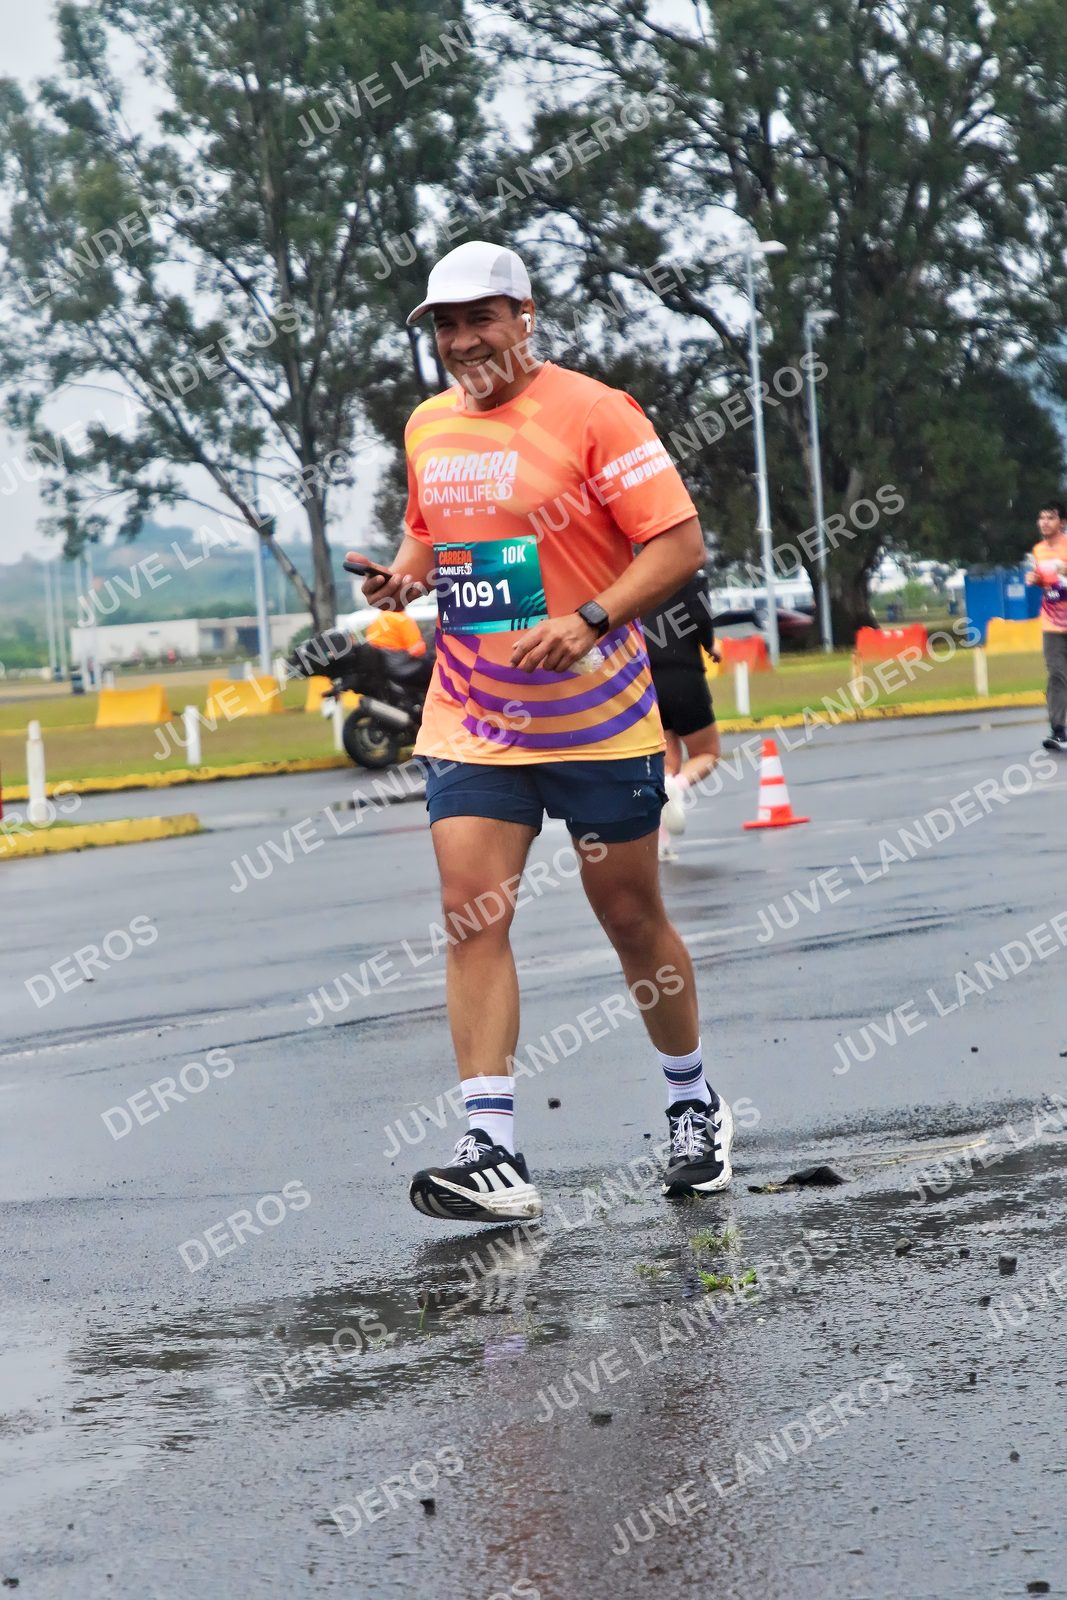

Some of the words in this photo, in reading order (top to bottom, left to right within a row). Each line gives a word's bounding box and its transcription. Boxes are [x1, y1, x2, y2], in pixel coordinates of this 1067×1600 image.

[424, 451, 518, 484] CARRERA
[423, 483, 495, 505] OMNILIFE
[438, 550, 472, 565] CARRERA
[502, 545, 526, 564] 10K
[439, 565, 465, 576] OMNILIFE
[451, 579, 512, 608] 1091
